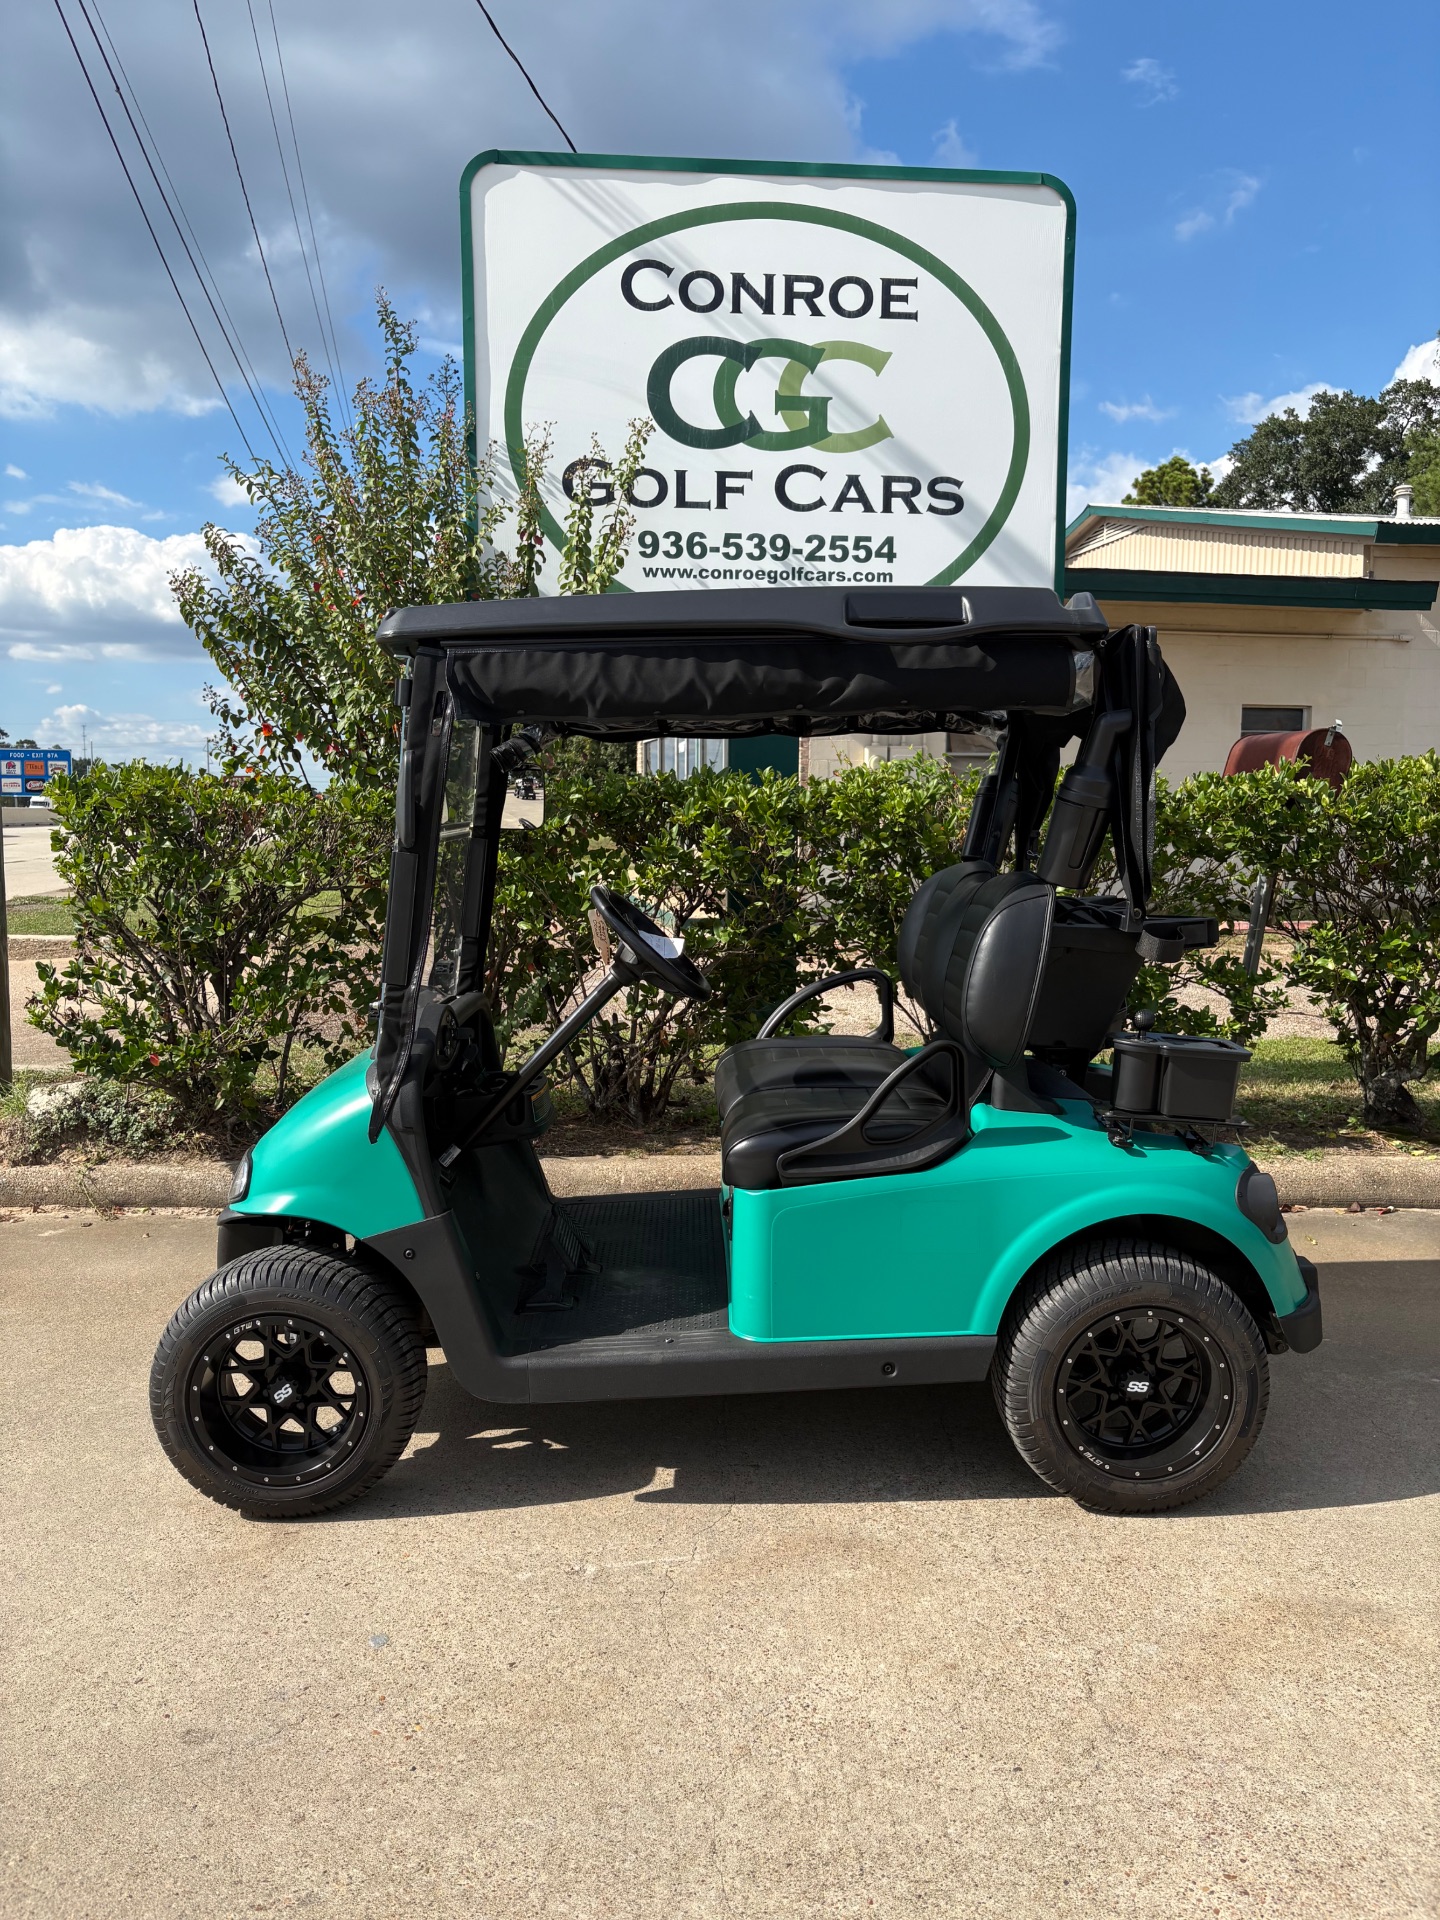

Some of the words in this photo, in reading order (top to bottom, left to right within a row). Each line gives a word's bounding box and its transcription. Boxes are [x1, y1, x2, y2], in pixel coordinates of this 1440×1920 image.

[620, 259, 918, 322] CONROE
[647, 336, 895, 453] CGC
[562, 458, 753, 512] GOLF
[774, 464, 965, 516] CARS
[637, 530, 897, 564] 936-539-2554
[642, 566, 894, 585] www.conroegolfcars.com
[233, 1321, 253, 1335] GTW
[273, 1383, 293, 1404] SS
[1126, 1380, 1150, 1393] SS
